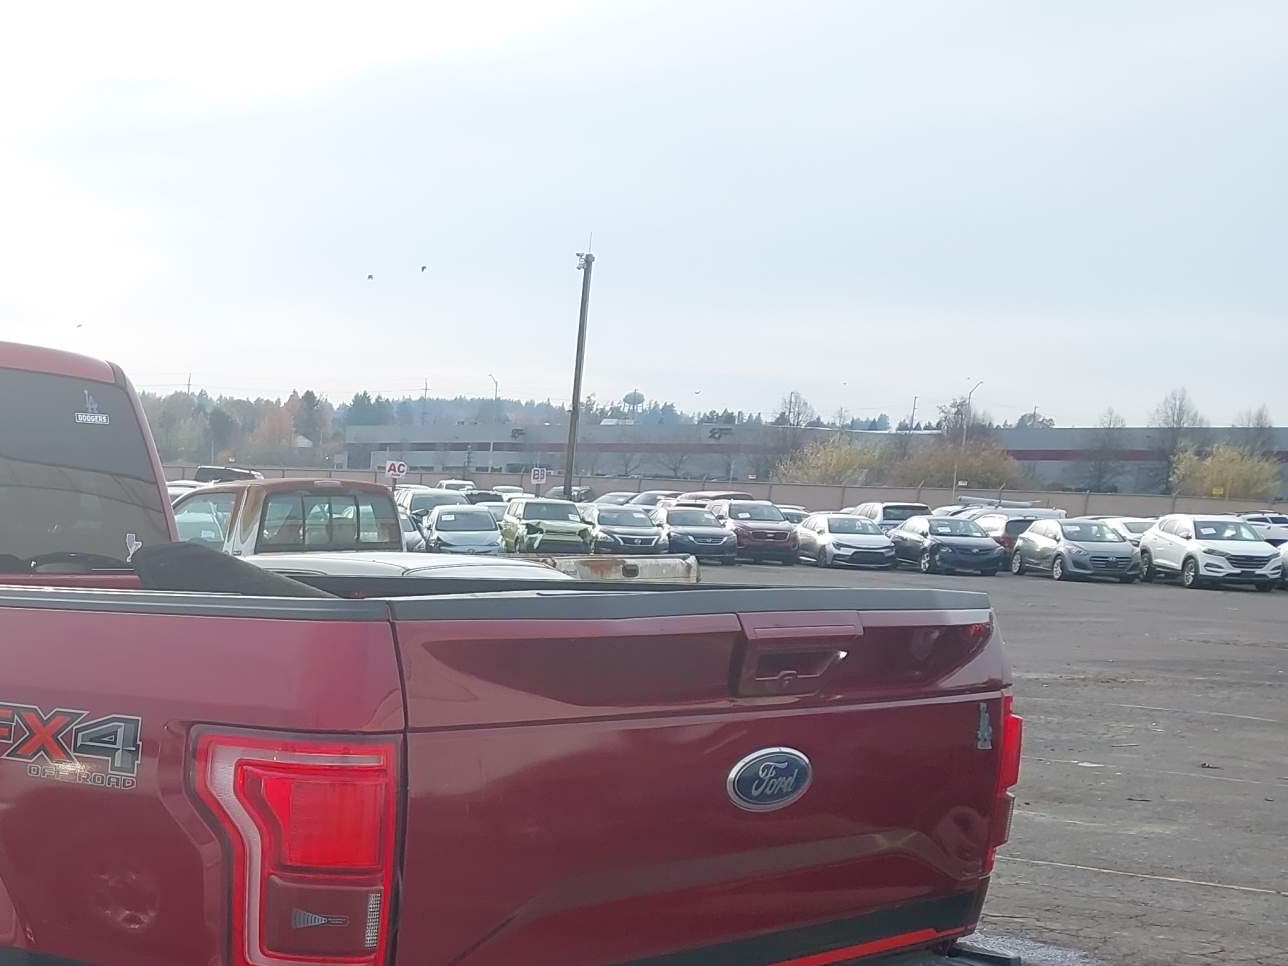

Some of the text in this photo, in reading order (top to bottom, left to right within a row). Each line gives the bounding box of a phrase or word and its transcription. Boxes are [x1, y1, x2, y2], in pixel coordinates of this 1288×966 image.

[387, 462, 406, 473] AC
[76, 770, 137, 790] ROAD
[751, 761, 799, 797] Ford
